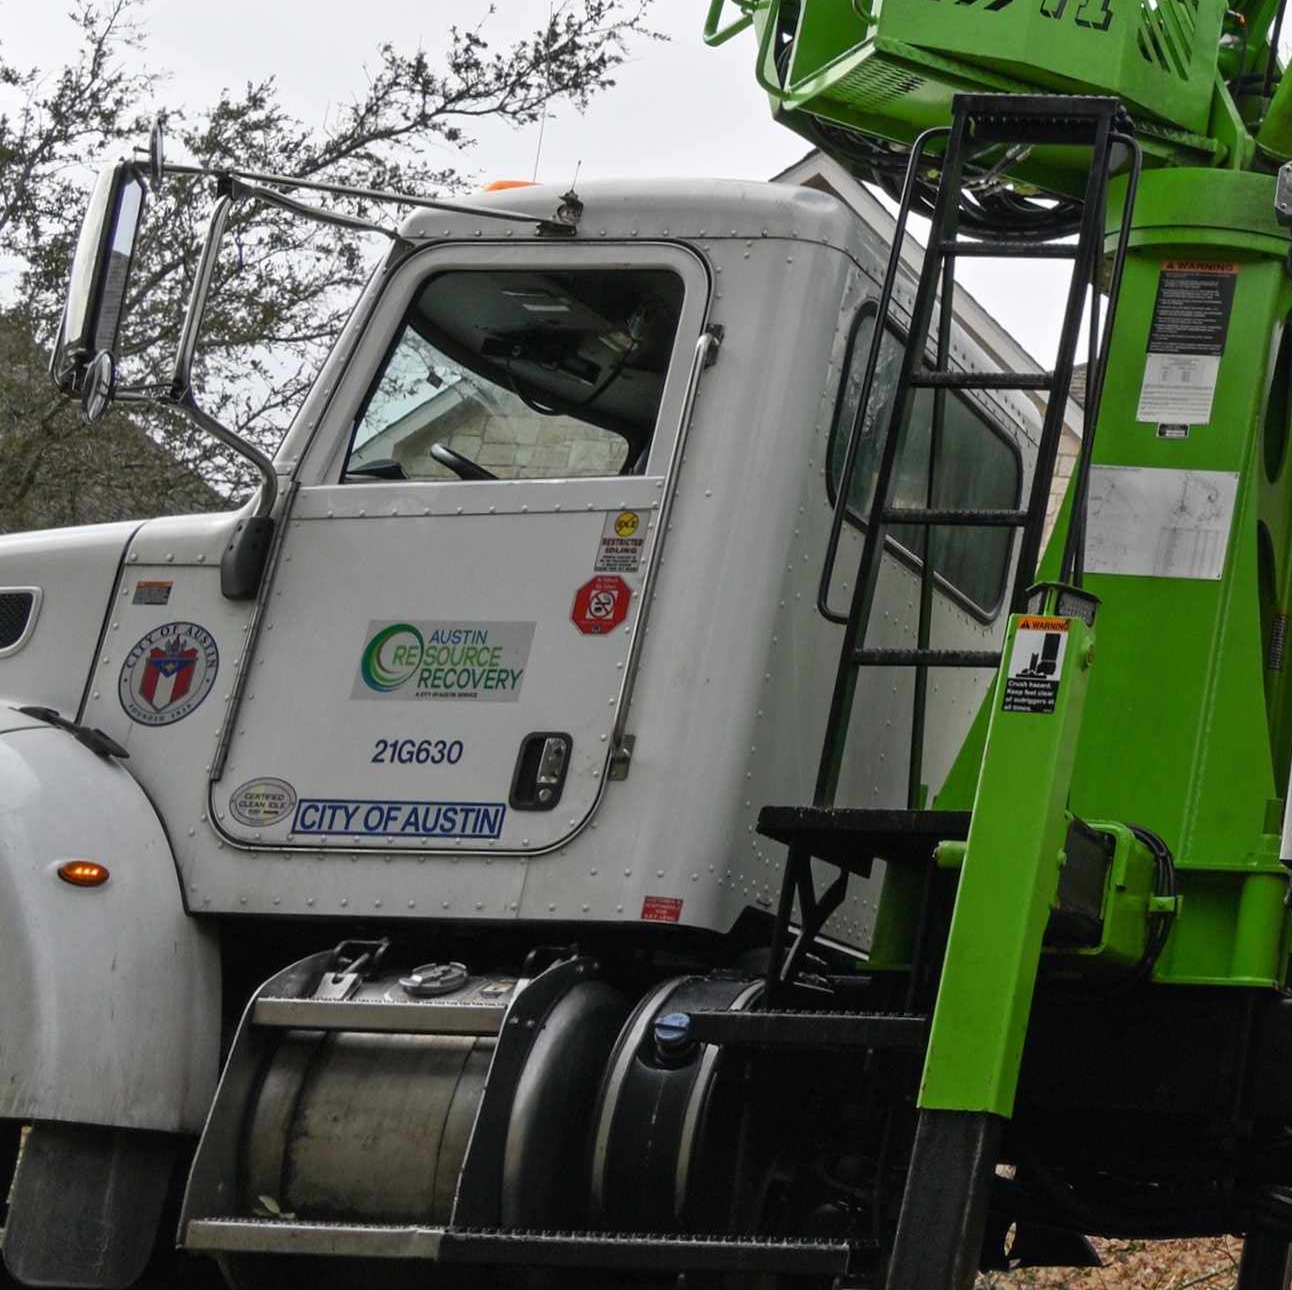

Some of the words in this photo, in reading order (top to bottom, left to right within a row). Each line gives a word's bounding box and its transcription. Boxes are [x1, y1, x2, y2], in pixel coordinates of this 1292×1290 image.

[1179, 261, 1234, 270] WARNING
[602, 538, 644, 546] RESTRICTED
[1032, 620, 1069, 631] WARNING
[429, 630, 488, 645] AUSTIN
[126, 634, 154, 669] CITY
[160, 624, 178, 637] OF
[185, 625, 217, 669] AUSTIN
[417, 667, 523, 690] RECOVERY
[1008, 680, 1028, 688] Crush
[1013, 697, 1047, 706] outriggers
[128, 703, 166, 722] FOUNDED
[371, 739, 464, 765] 21G630
[245, 792, 285, 800] CERTIFIED
[300, 803, 361, 831] CITY
[363, 805, 402, 832] OF
[400, 806, 500, 834] AUSTIN
